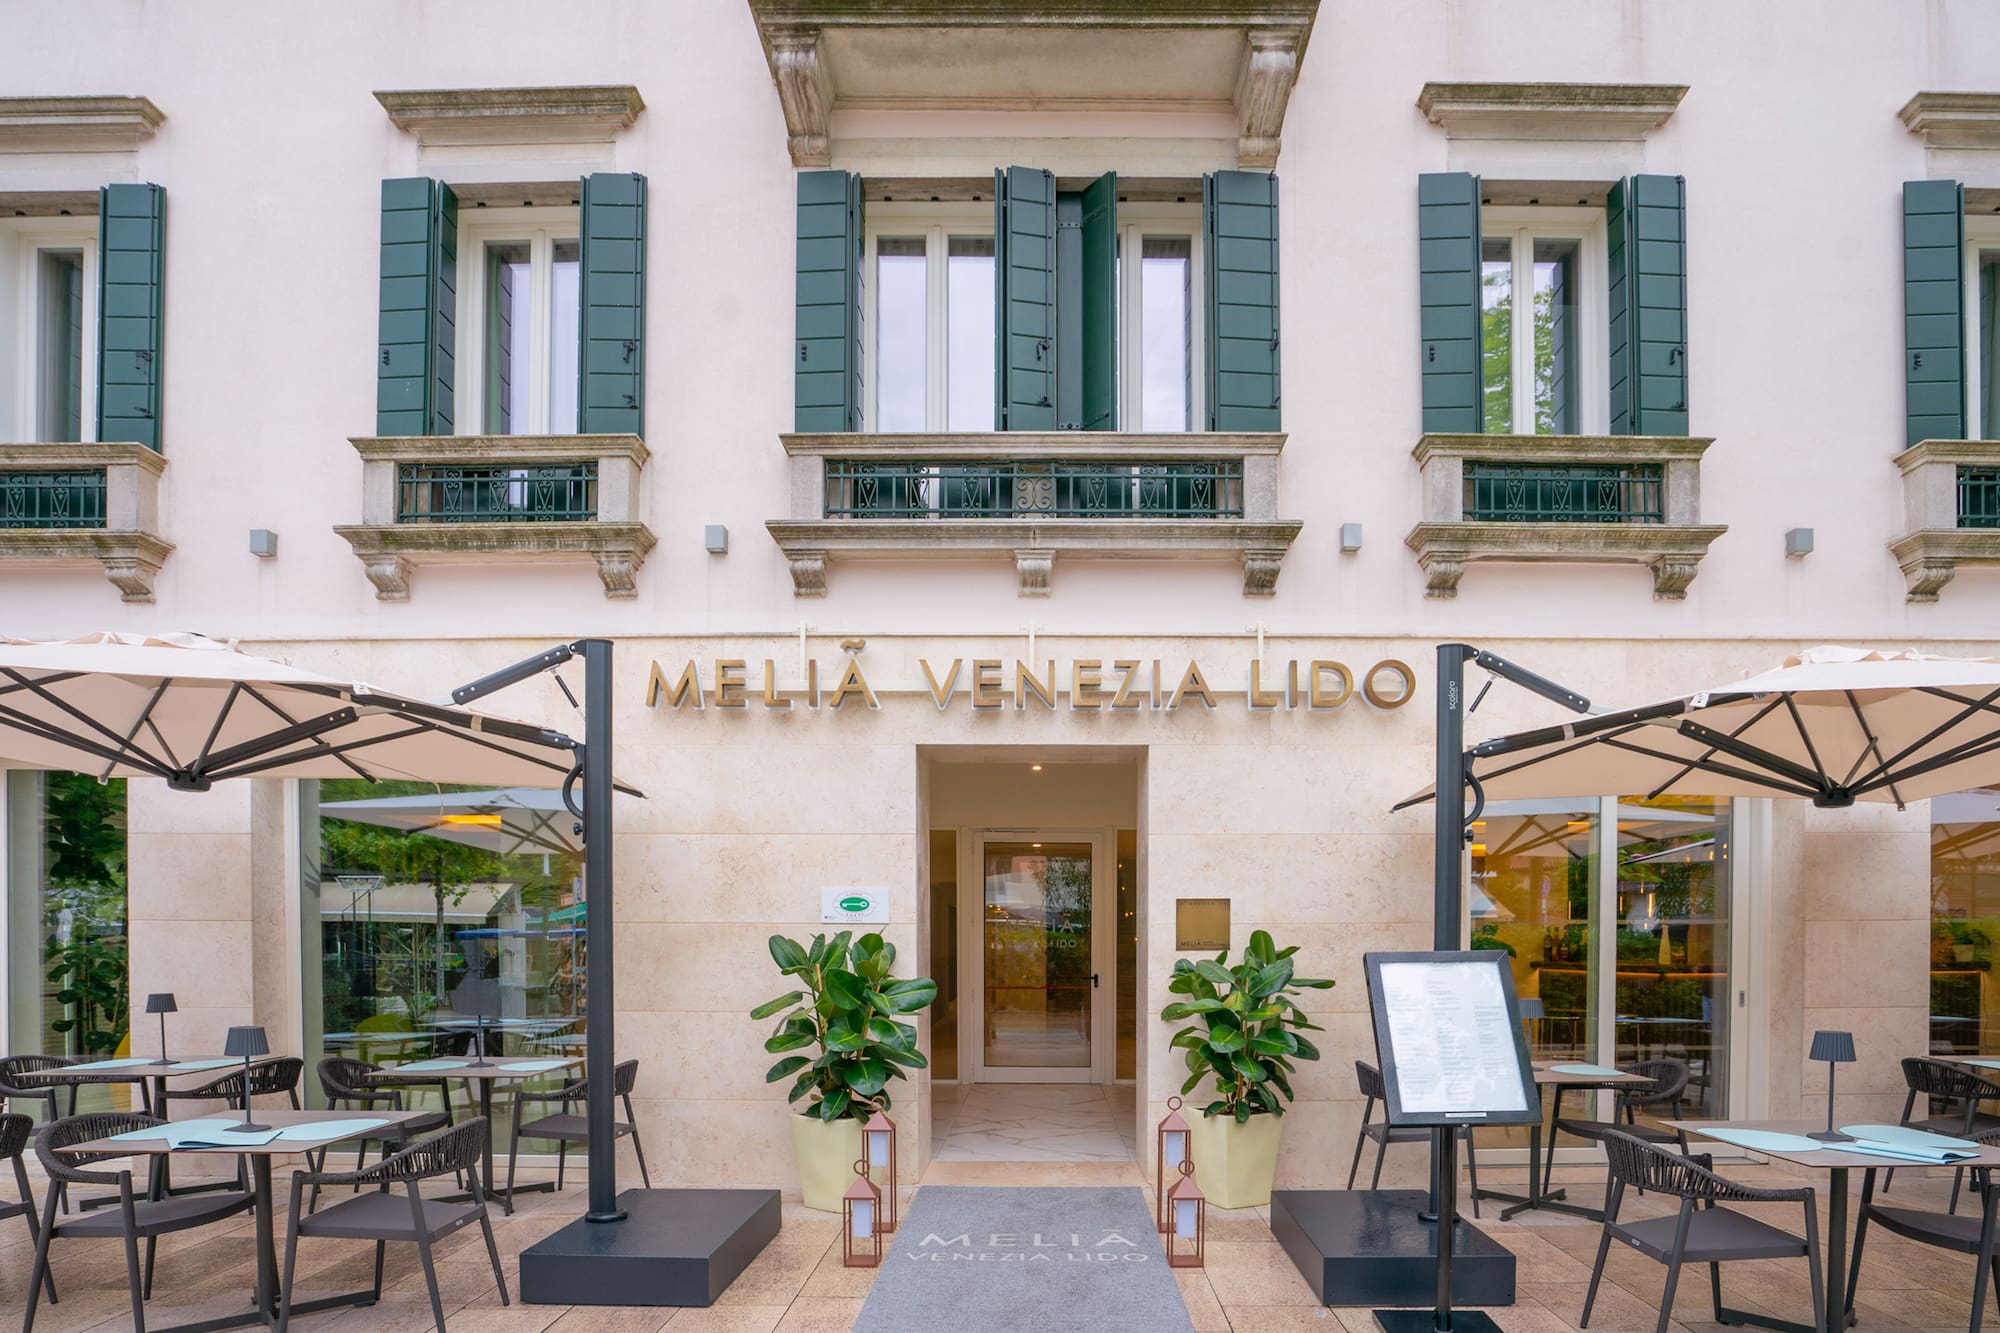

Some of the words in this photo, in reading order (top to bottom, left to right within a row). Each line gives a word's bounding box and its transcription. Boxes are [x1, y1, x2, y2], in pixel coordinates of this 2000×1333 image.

[646, 639, 879, 708] MELIÃ
[918, 658, 1218, 709] VENEZIA
[1248, 658, 1417, 710] LIDO
[905, 1251, 1051, 1262] VENEZIA
[1067, 1252, 1149, 1263] LIDO
